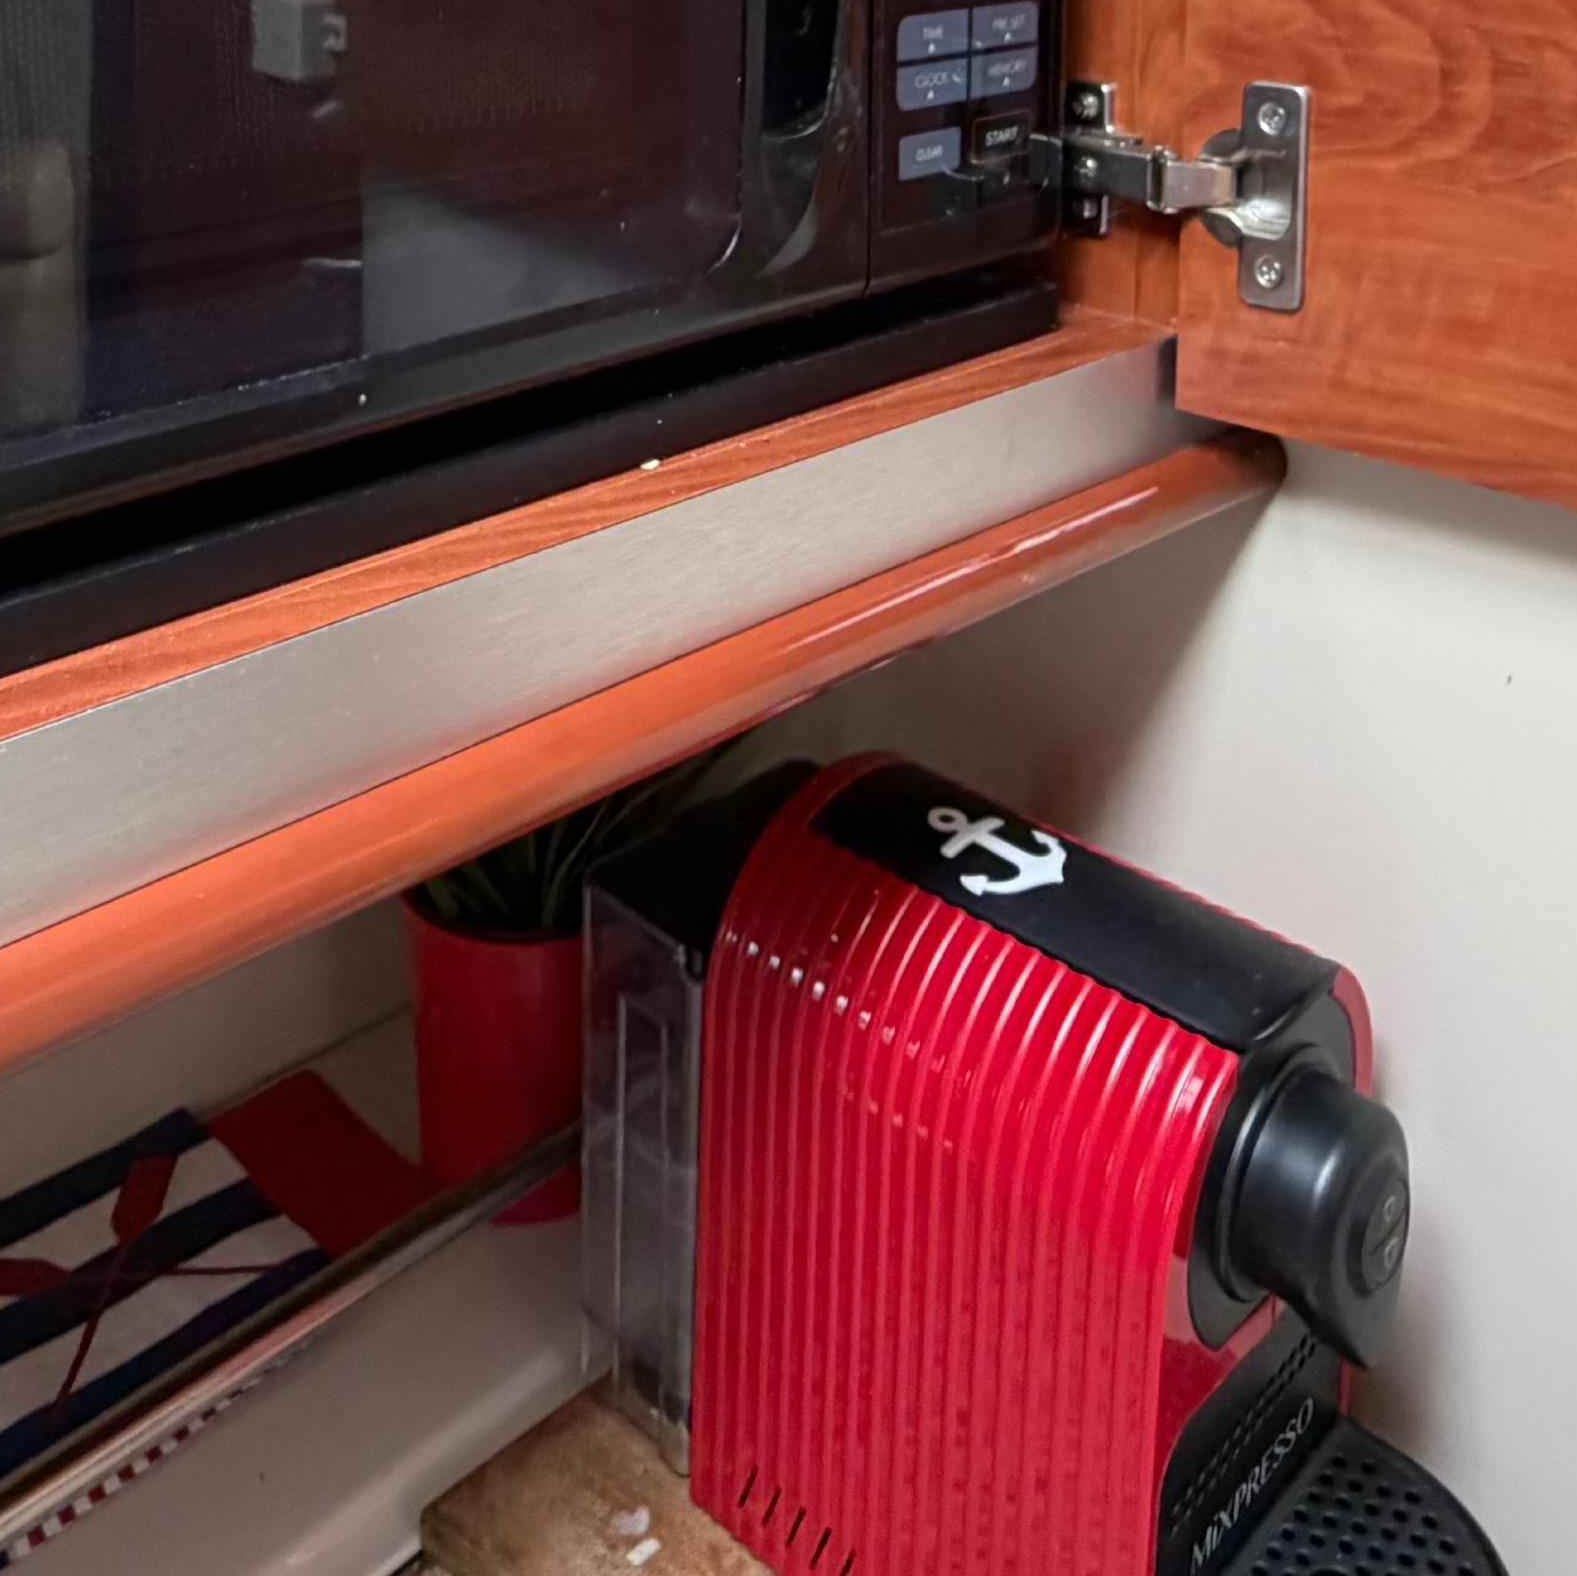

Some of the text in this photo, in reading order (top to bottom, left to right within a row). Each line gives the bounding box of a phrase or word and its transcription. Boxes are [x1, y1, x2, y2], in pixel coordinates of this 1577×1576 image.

[913, 70, 949, 89] CLOCK
[985, 125, 1019, 147] START
[915, 144, 943, 163] CLEAR
